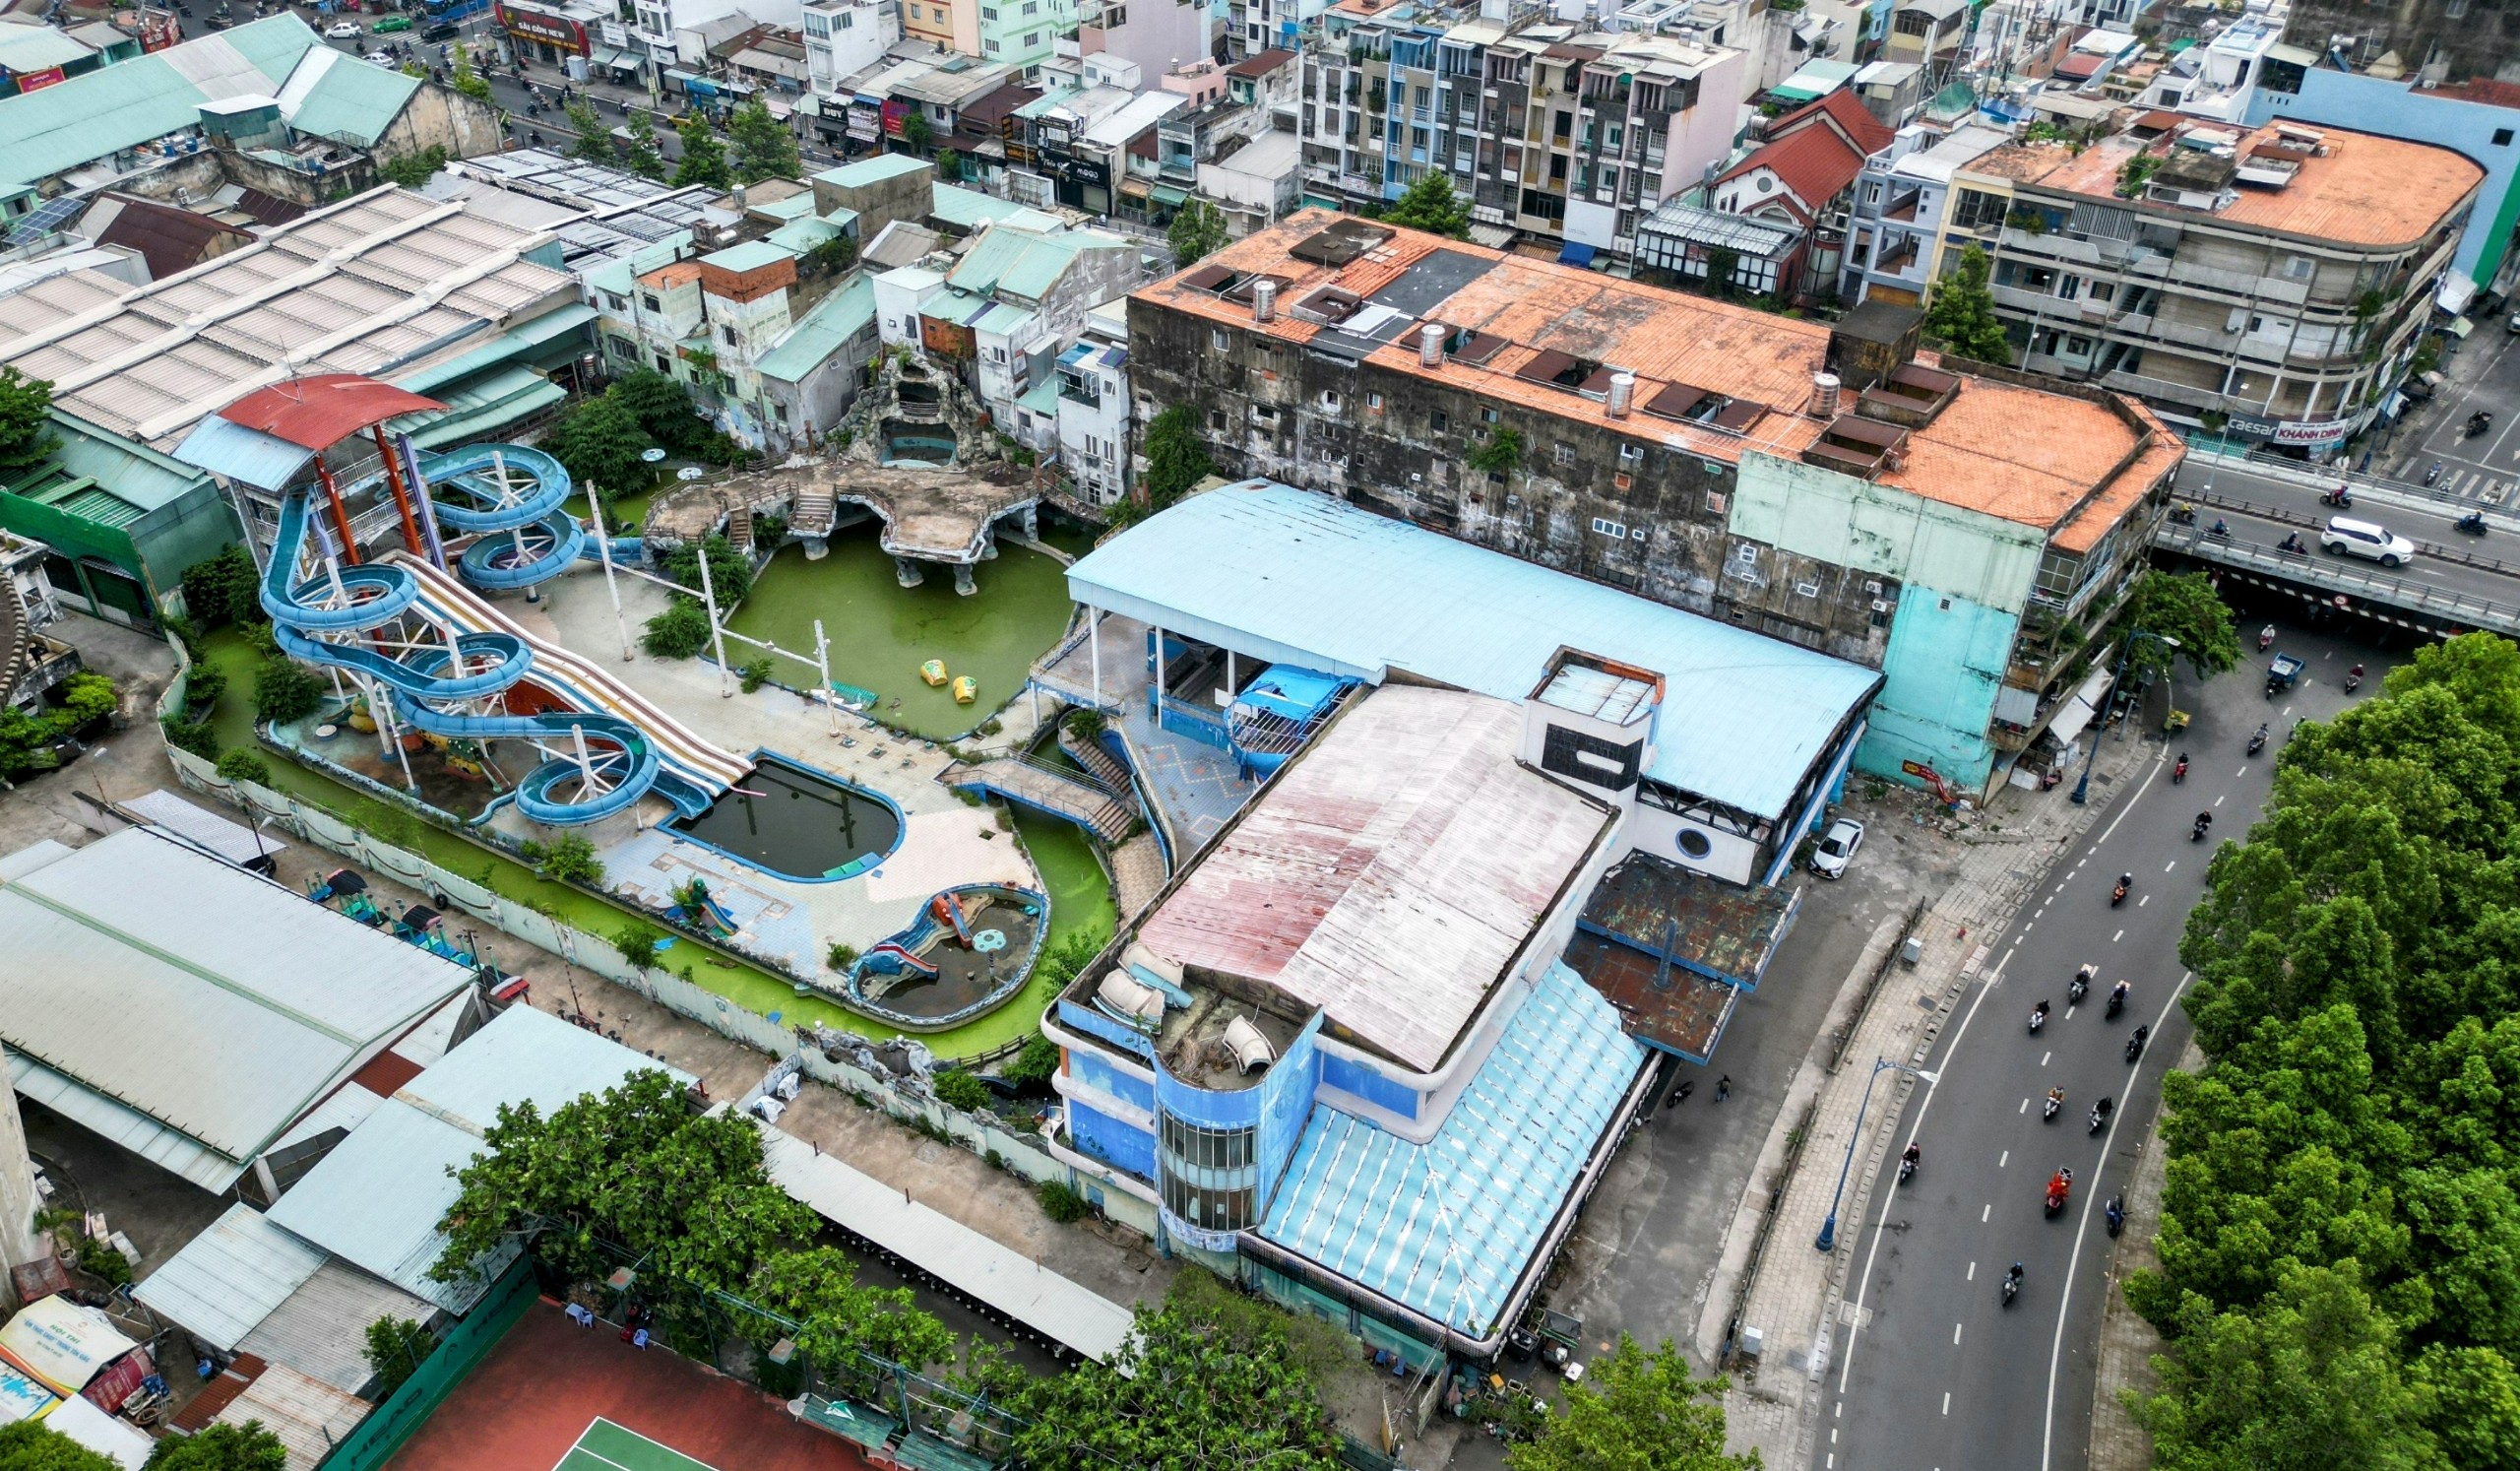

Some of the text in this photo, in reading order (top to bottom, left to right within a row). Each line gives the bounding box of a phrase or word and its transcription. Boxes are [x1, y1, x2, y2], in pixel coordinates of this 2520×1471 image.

[518, 21, 565, 38] SÀI GÒN NEW
[823, 107, 844, 118] DUY
[2229, 418, 2278, 435] caesar
[2278, 426, 2318, 439] KHÁNH
[350, 1387, 422, 1465] HEAD
